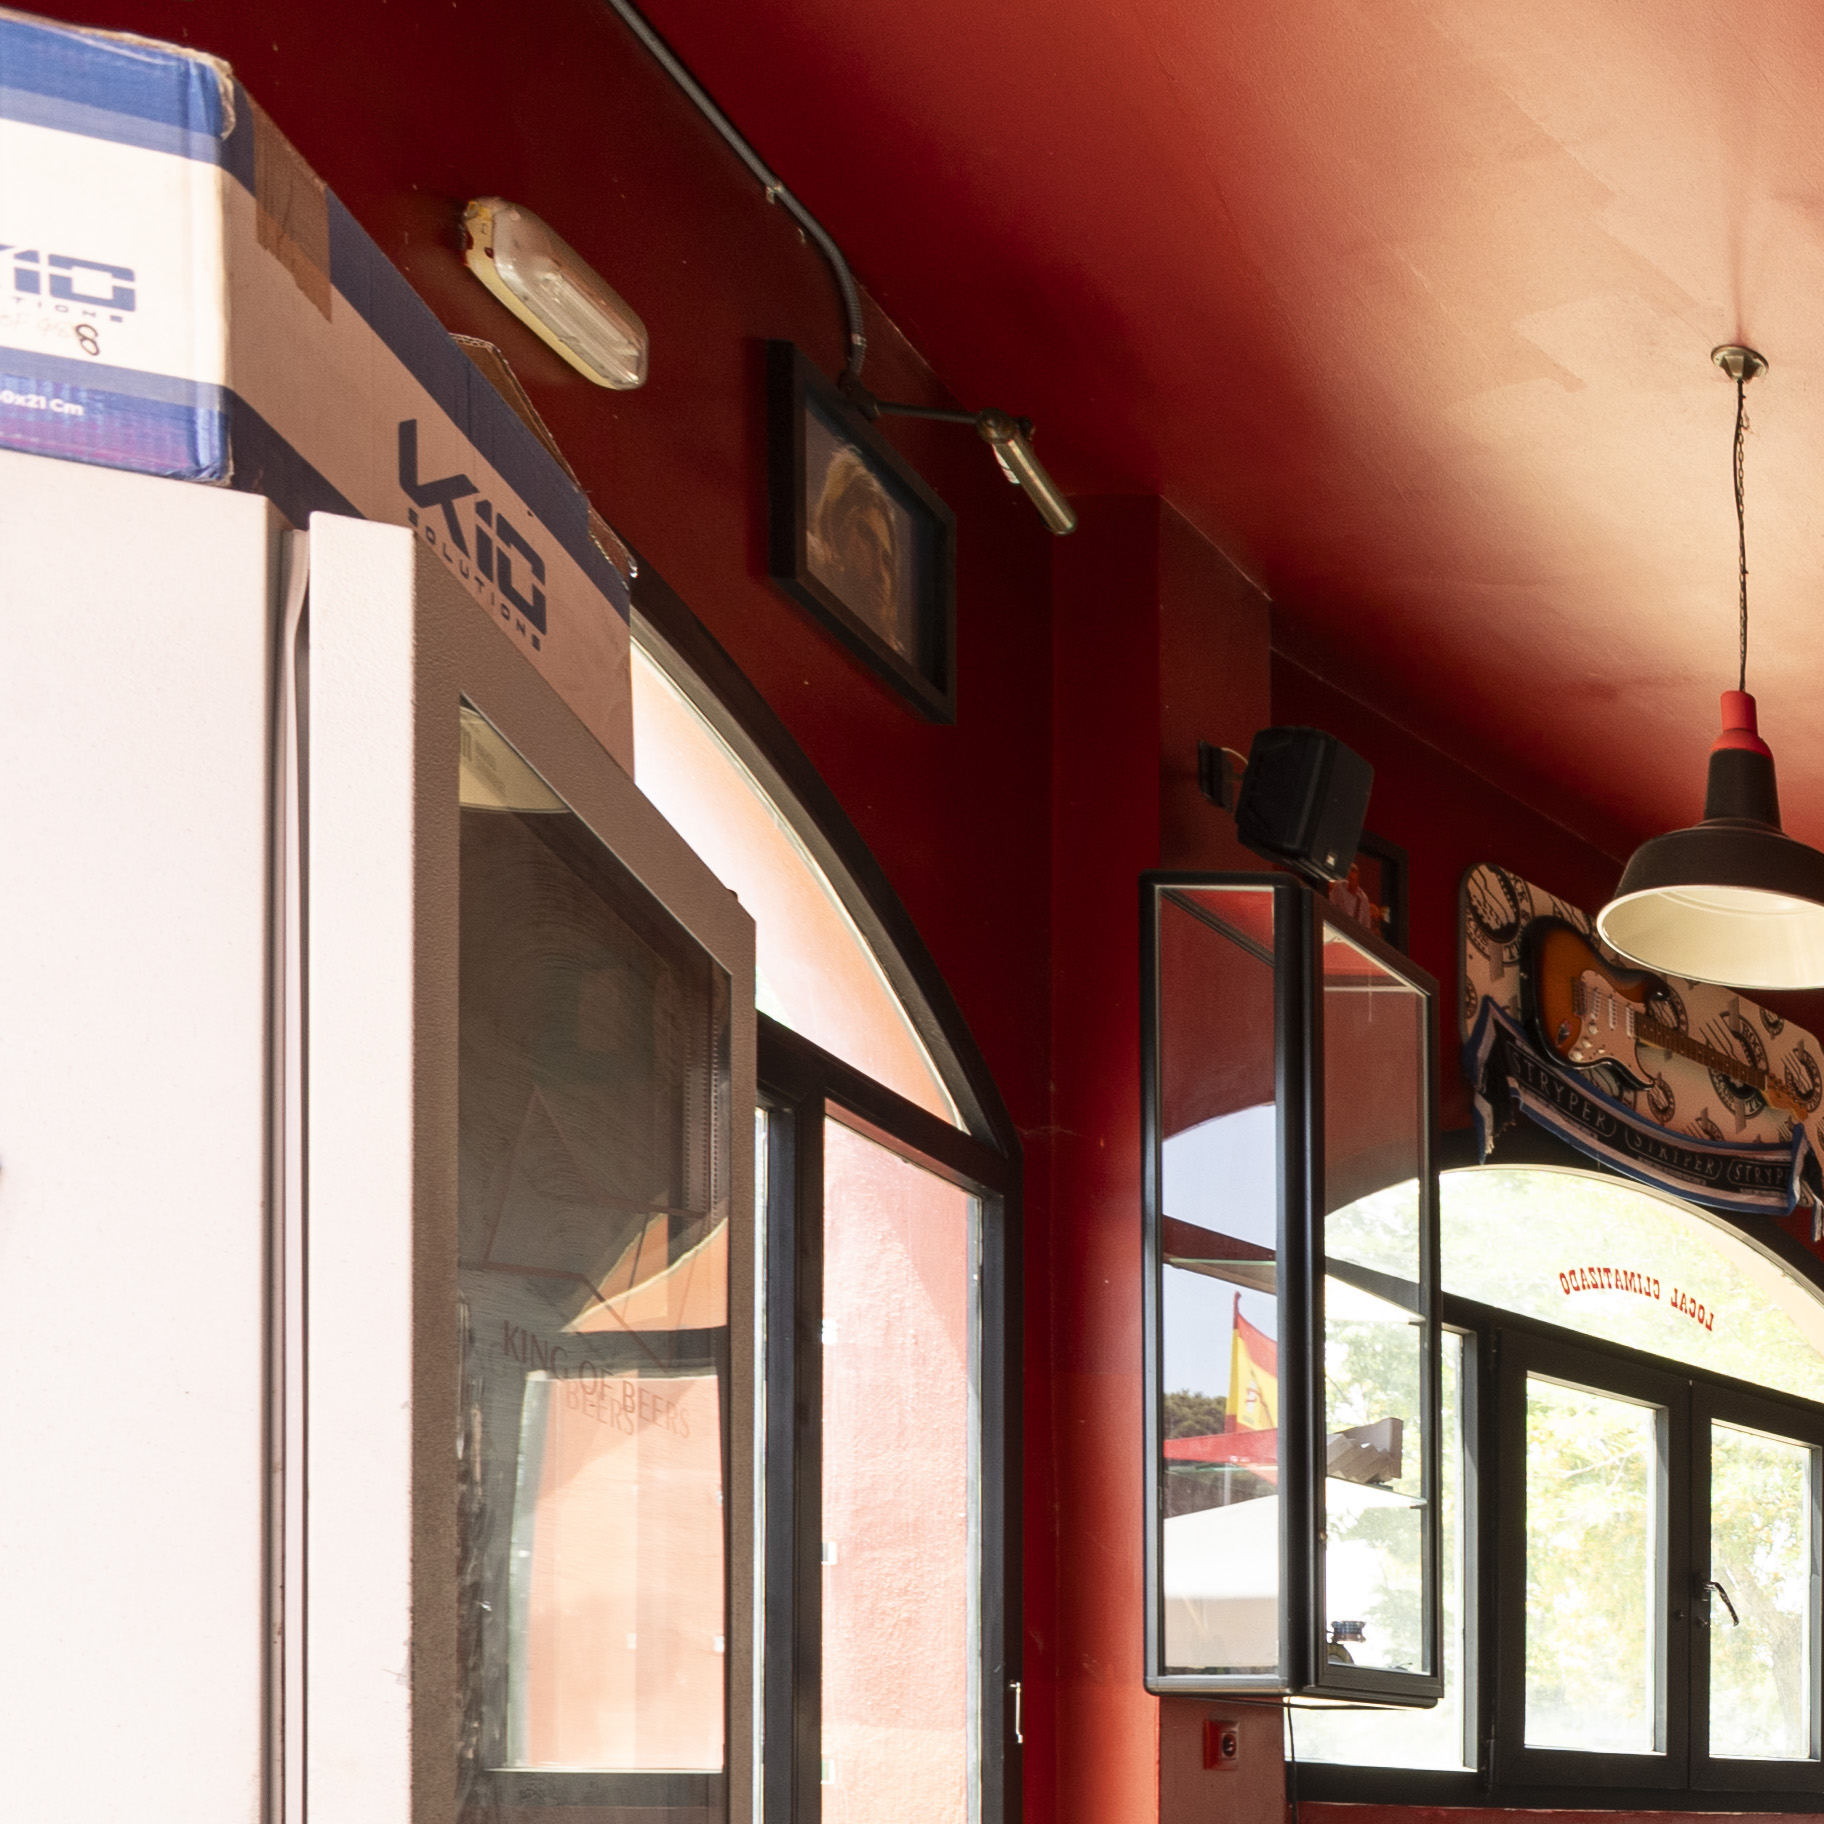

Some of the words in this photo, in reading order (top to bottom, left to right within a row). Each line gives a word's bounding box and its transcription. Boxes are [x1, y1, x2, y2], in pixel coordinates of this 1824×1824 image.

[49, 400, 84, 416] Cm
[408, 507, 541, 651] SOLUTIONS
[1511, 1051, 1608, 1134] STRYPER
[503, 1320, 569, 1381] KING
[579, 1360, 614, 1400] OF
[622, 1380, 691, 1439] BEERS
